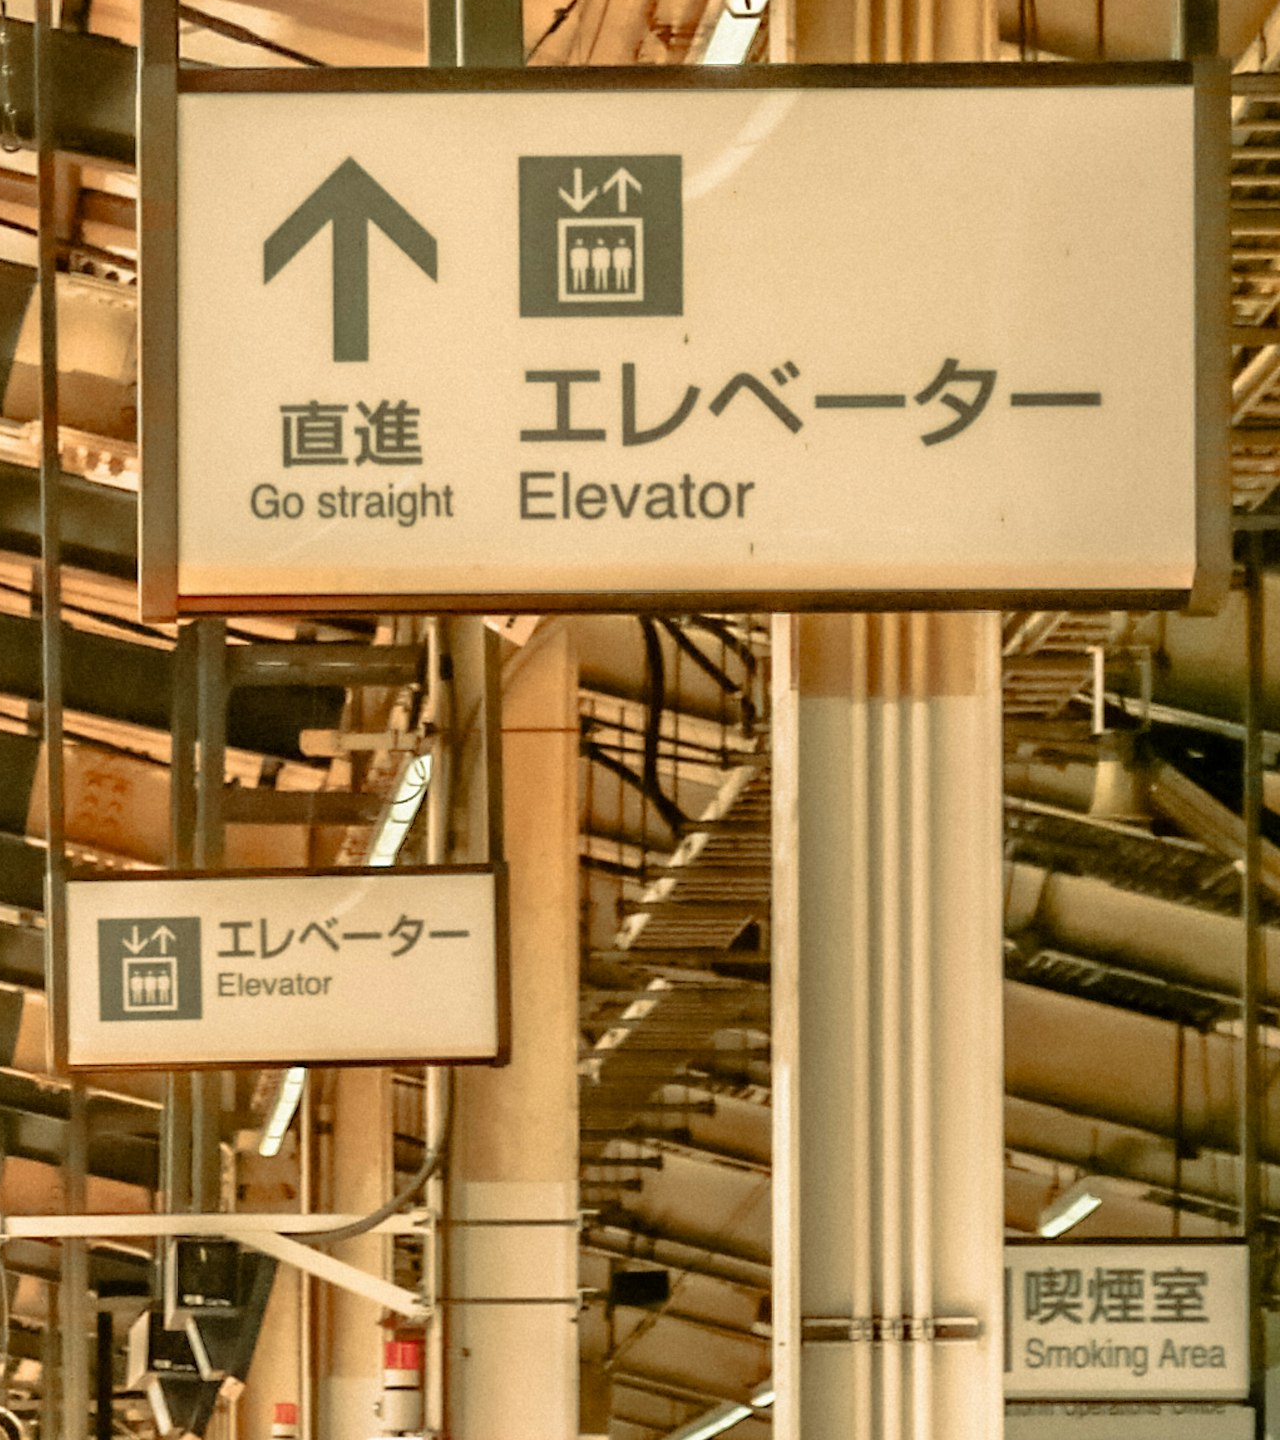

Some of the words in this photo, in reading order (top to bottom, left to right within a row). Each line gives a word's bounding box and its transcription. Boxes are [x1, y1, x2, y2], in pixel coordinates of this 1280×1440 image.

[520, 357, 1104, 448] エレベーター
[278, 398, 425, 468] 直進
[250, 483, 304, 521] Go
[317, 481, 455, 528] straight
[519, 471, 755, 521] Elevator
[216, 915, 470, 959] エレベーター
[217, 968, 332, 999] Elevator
[1023, 1266, 1210, 1325] 喫煙室
[1024, 1337, 1149, 1377] Smoking
[1158, 1338, 1227, 1370] Area
